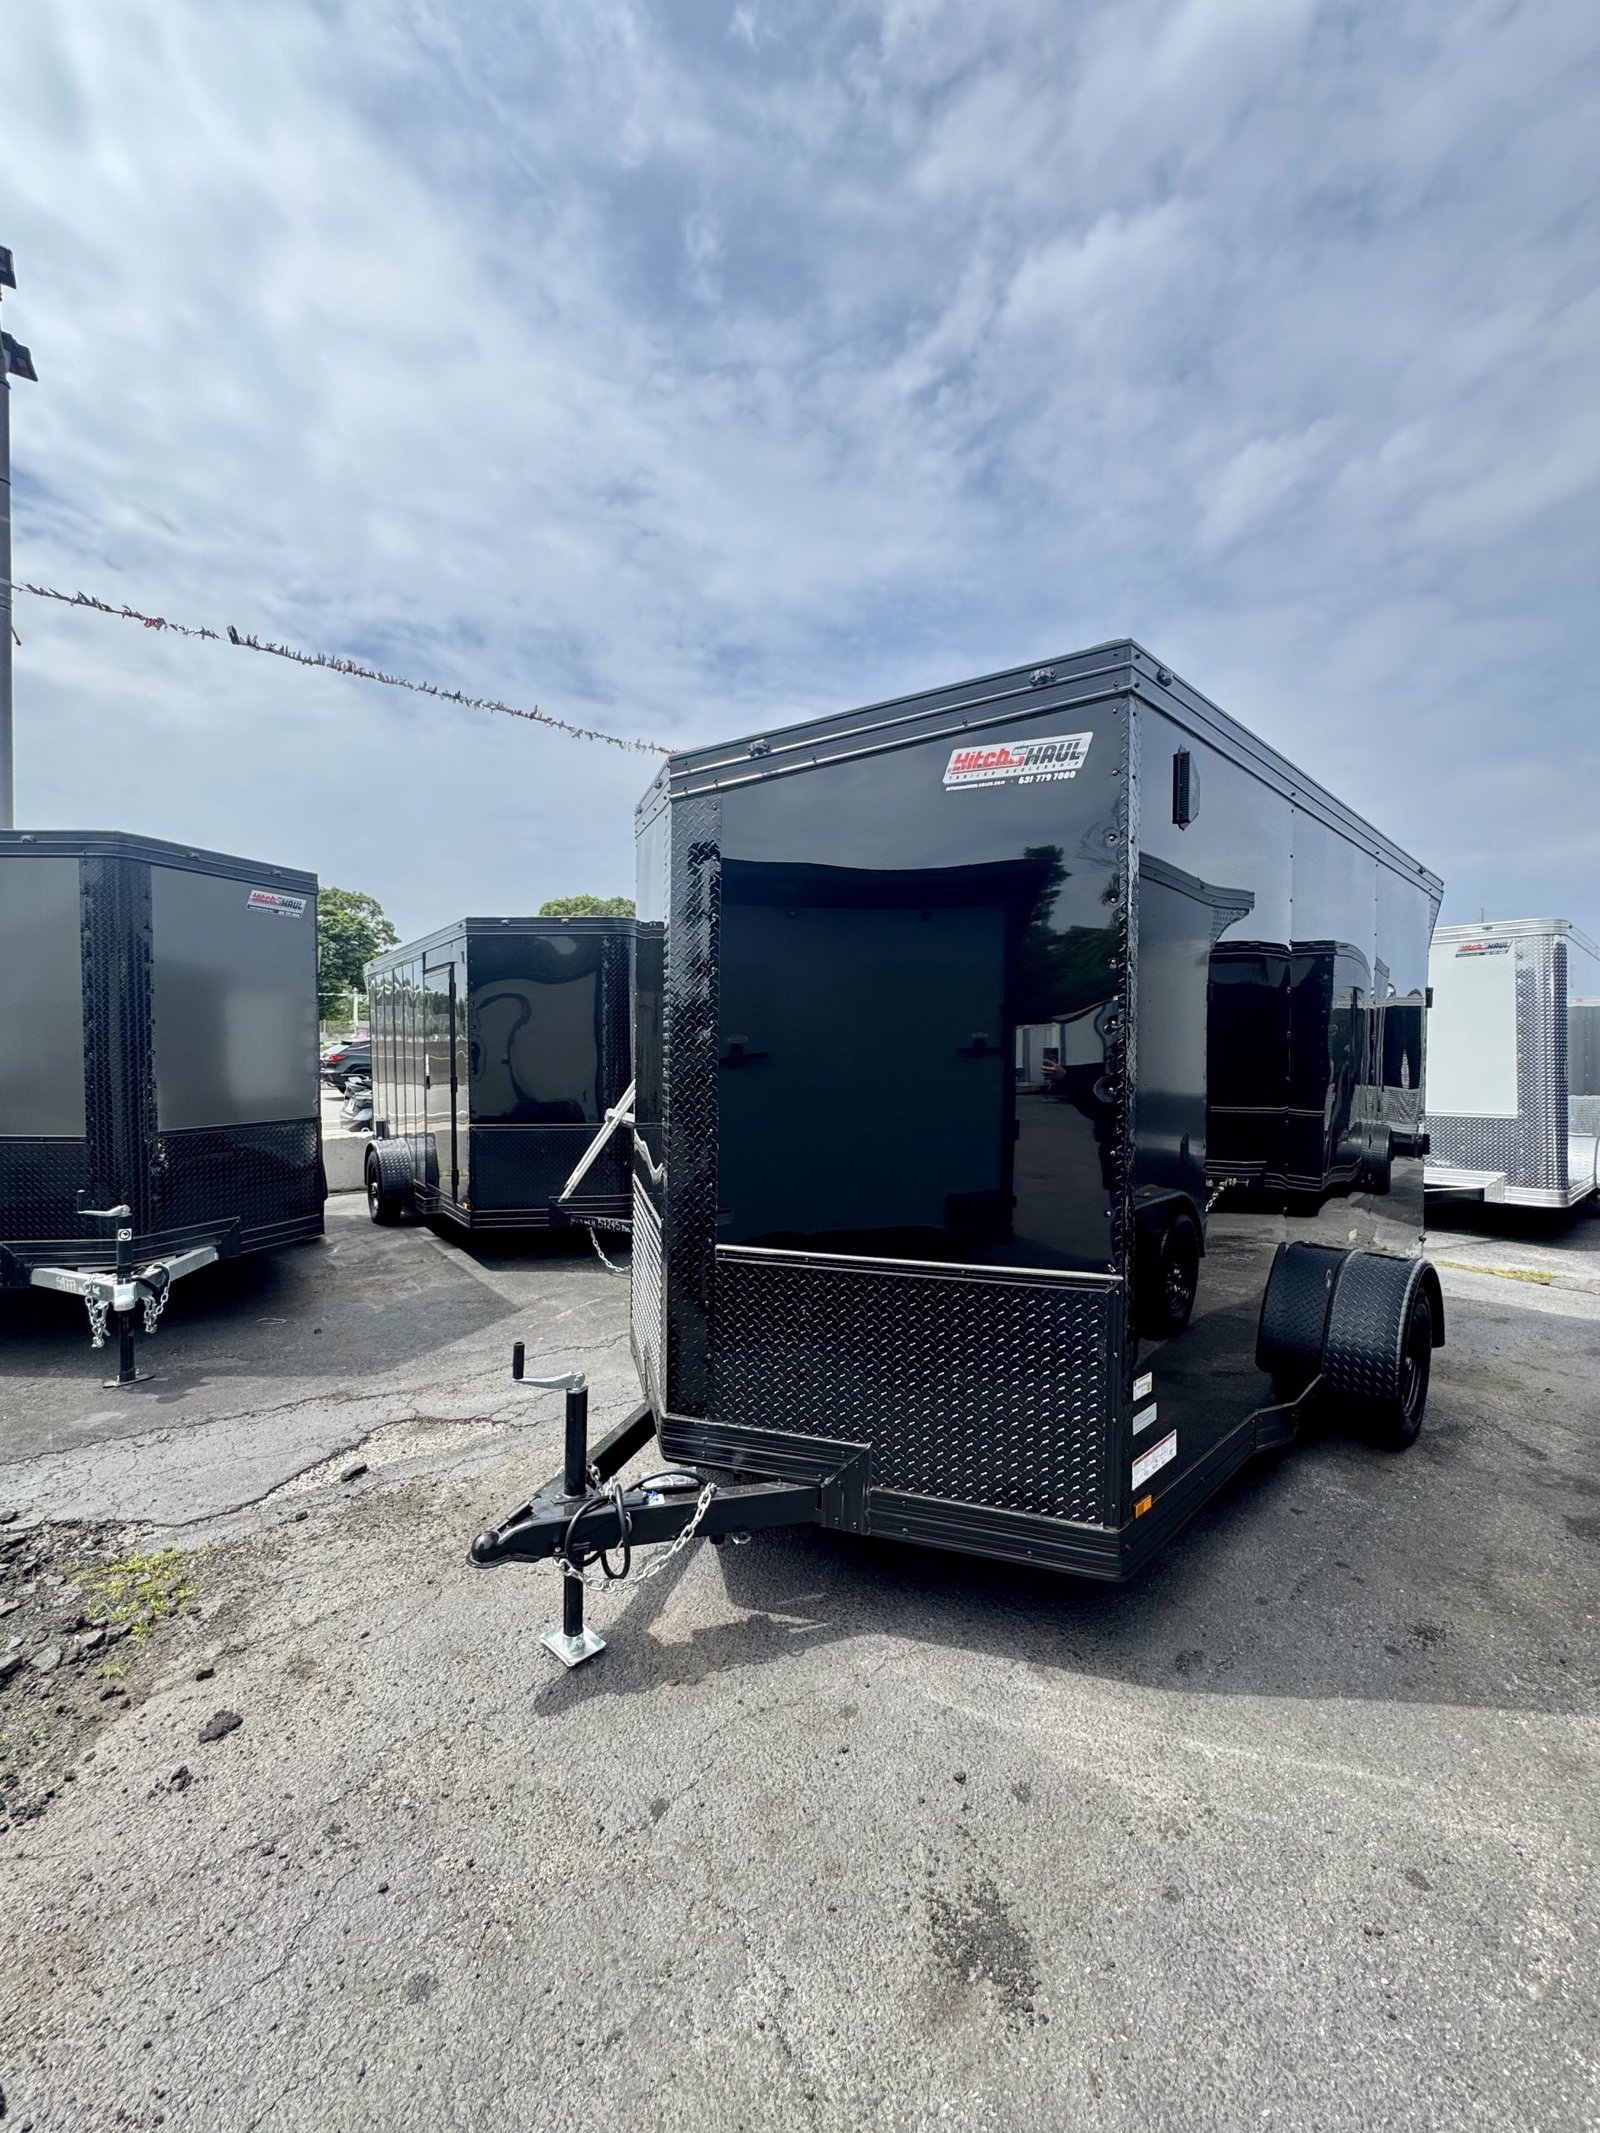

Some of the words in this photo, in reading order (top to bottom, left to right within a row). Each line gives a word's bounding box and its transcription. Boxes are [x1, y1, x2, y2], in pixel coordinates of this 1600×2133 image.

[952, 748, 1012, 771] Hitch
[1024, 742, 1081, 766] HAUL
[281, 899, 304, 910] HAUL
